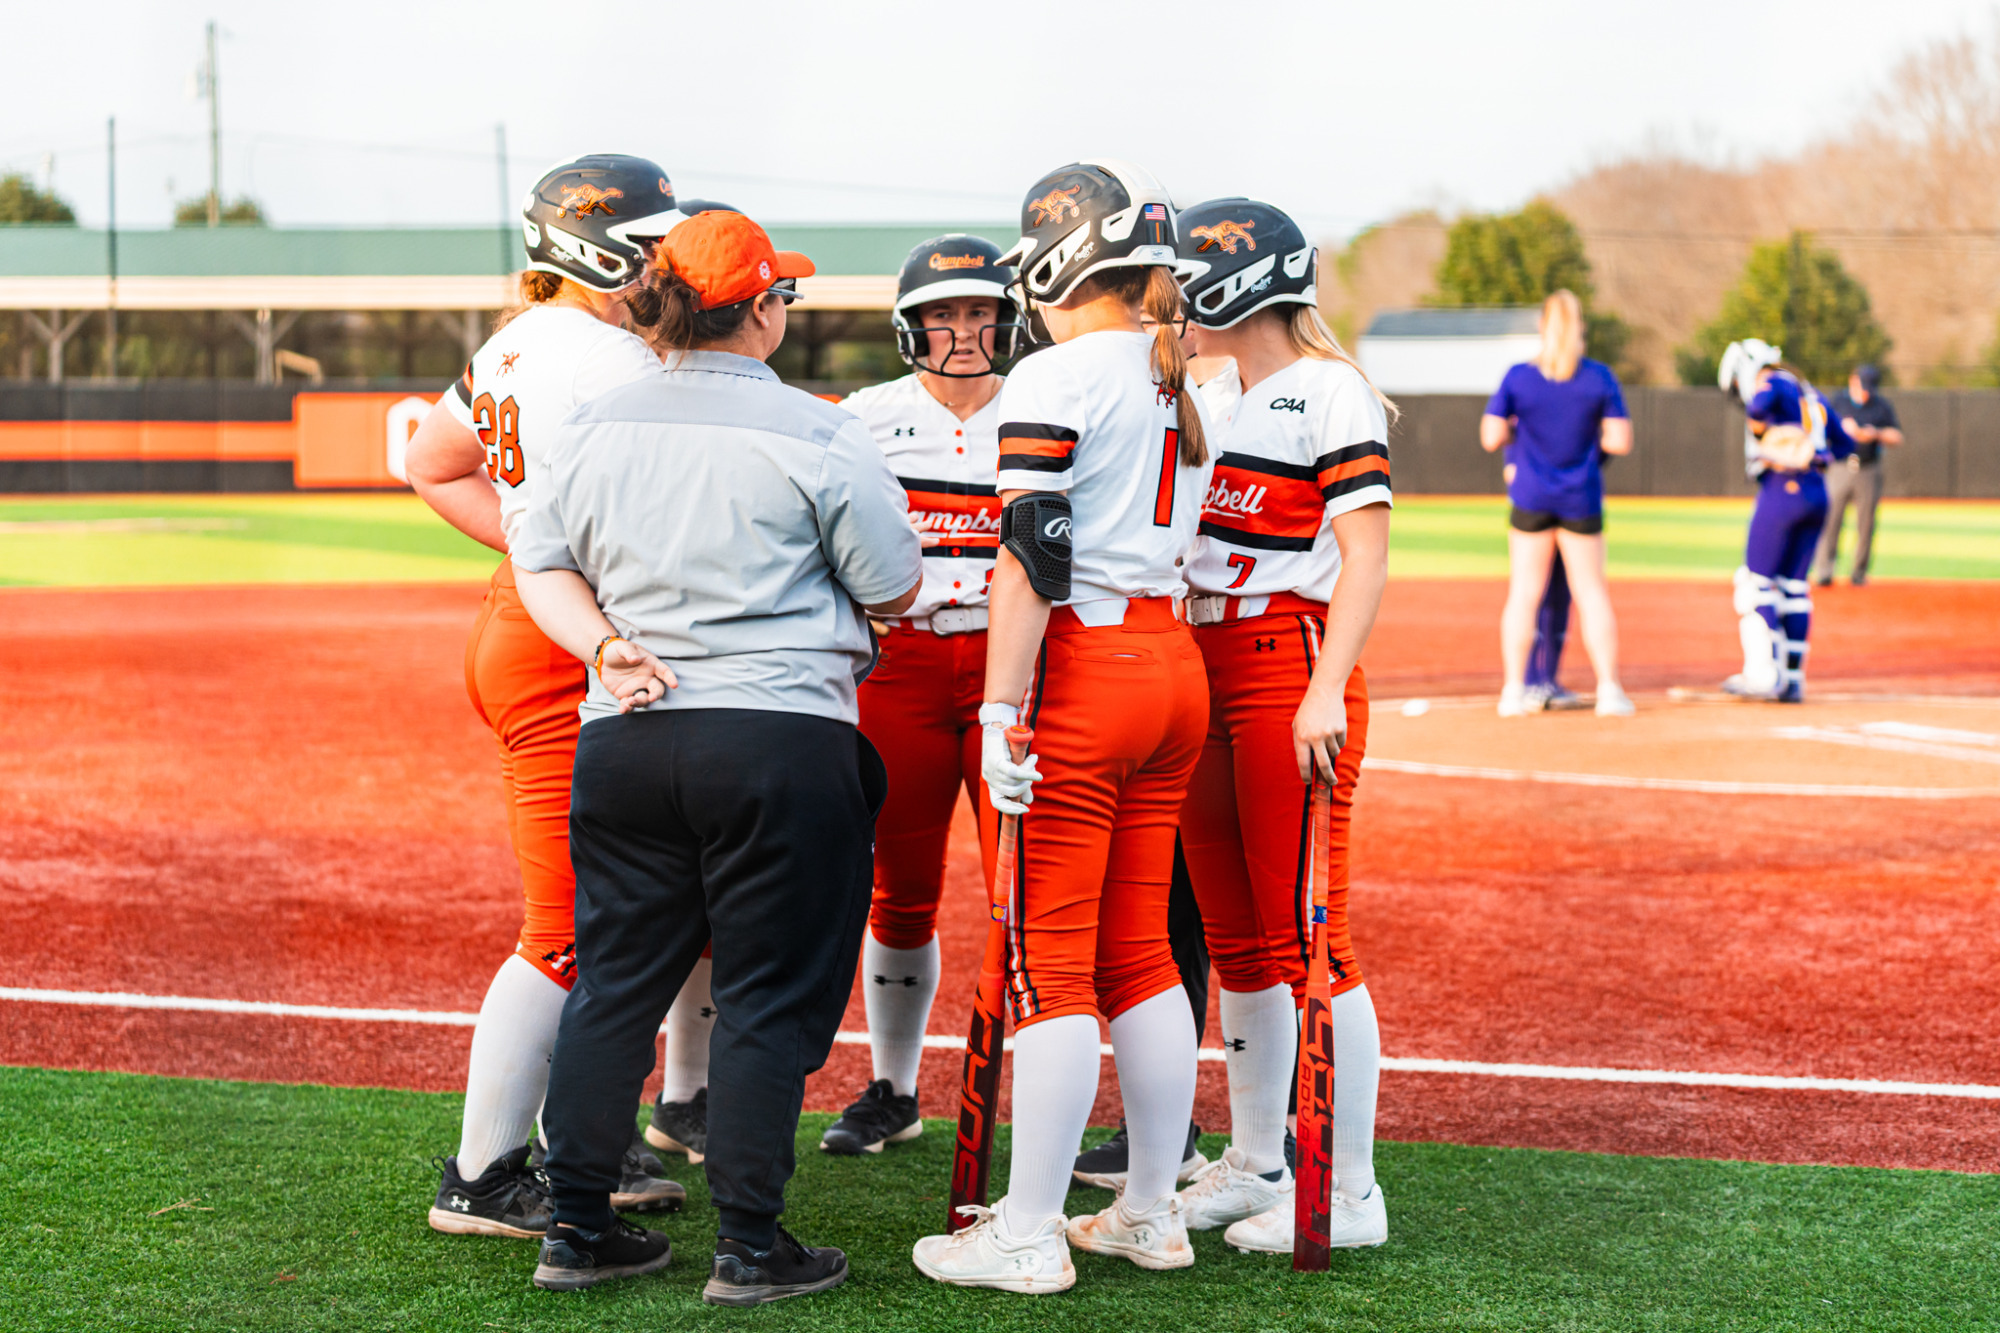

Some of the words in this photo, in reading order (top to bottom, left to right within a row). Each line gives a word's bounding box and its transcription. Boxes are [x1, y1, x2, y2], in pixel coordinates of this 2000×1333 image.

[928, 252, 985, 271] Campbell
[1269, 397, 1306, 414] CAA
[472, 391, 526, 489] 28
[1153, 426, 1180, 528] 1
[1225, 552, 1257, 589] 7
